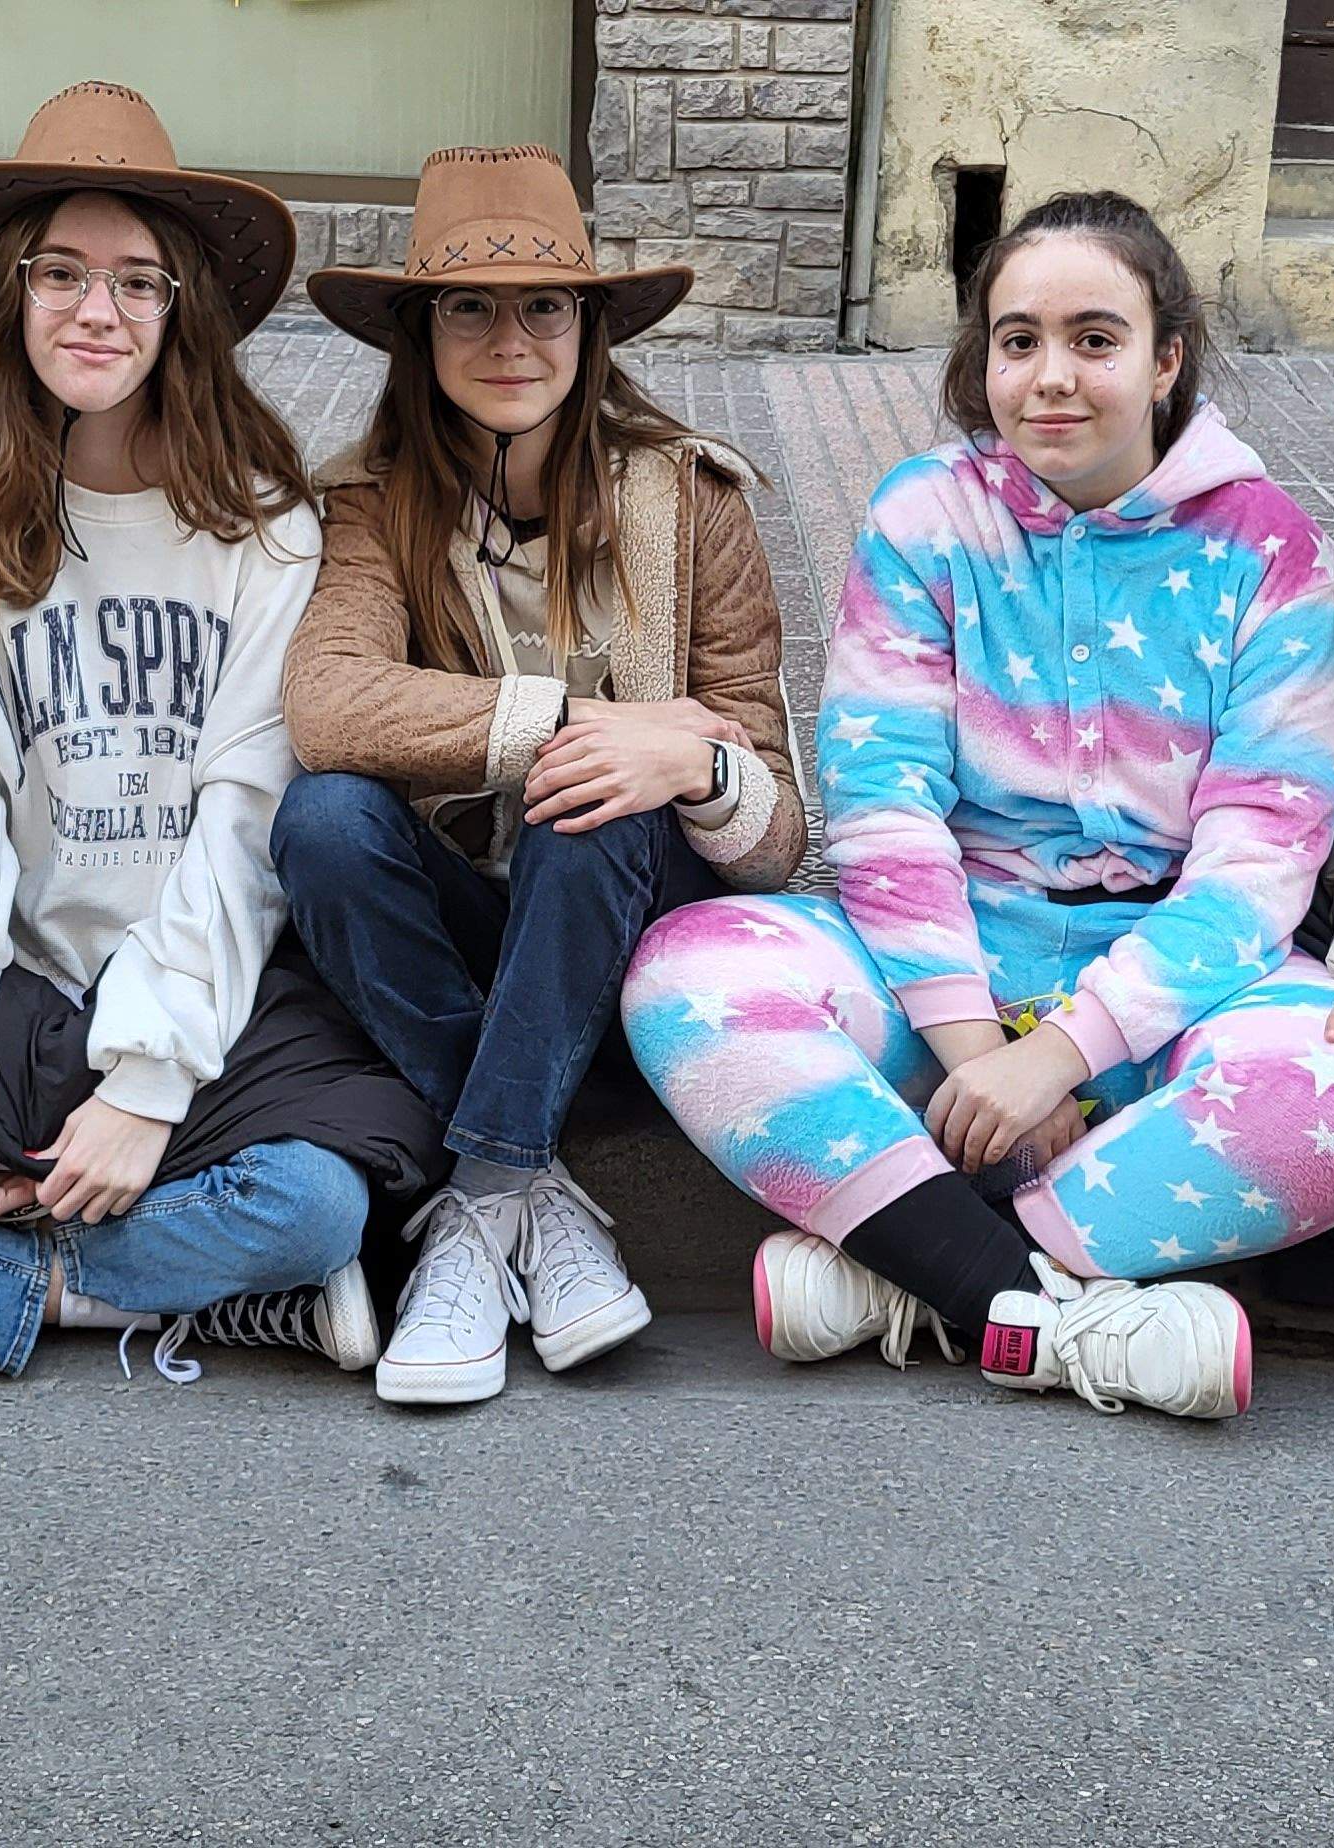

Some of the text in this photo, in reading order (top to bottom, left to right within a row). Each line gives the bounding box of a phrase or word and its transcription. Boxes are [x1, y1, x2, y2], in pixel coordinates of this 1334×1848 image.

[54, 726, 123, 768] EST.
[117, 771, 149, 797] USA
[1005, 1331, 1022, 1370] ALL STAR
